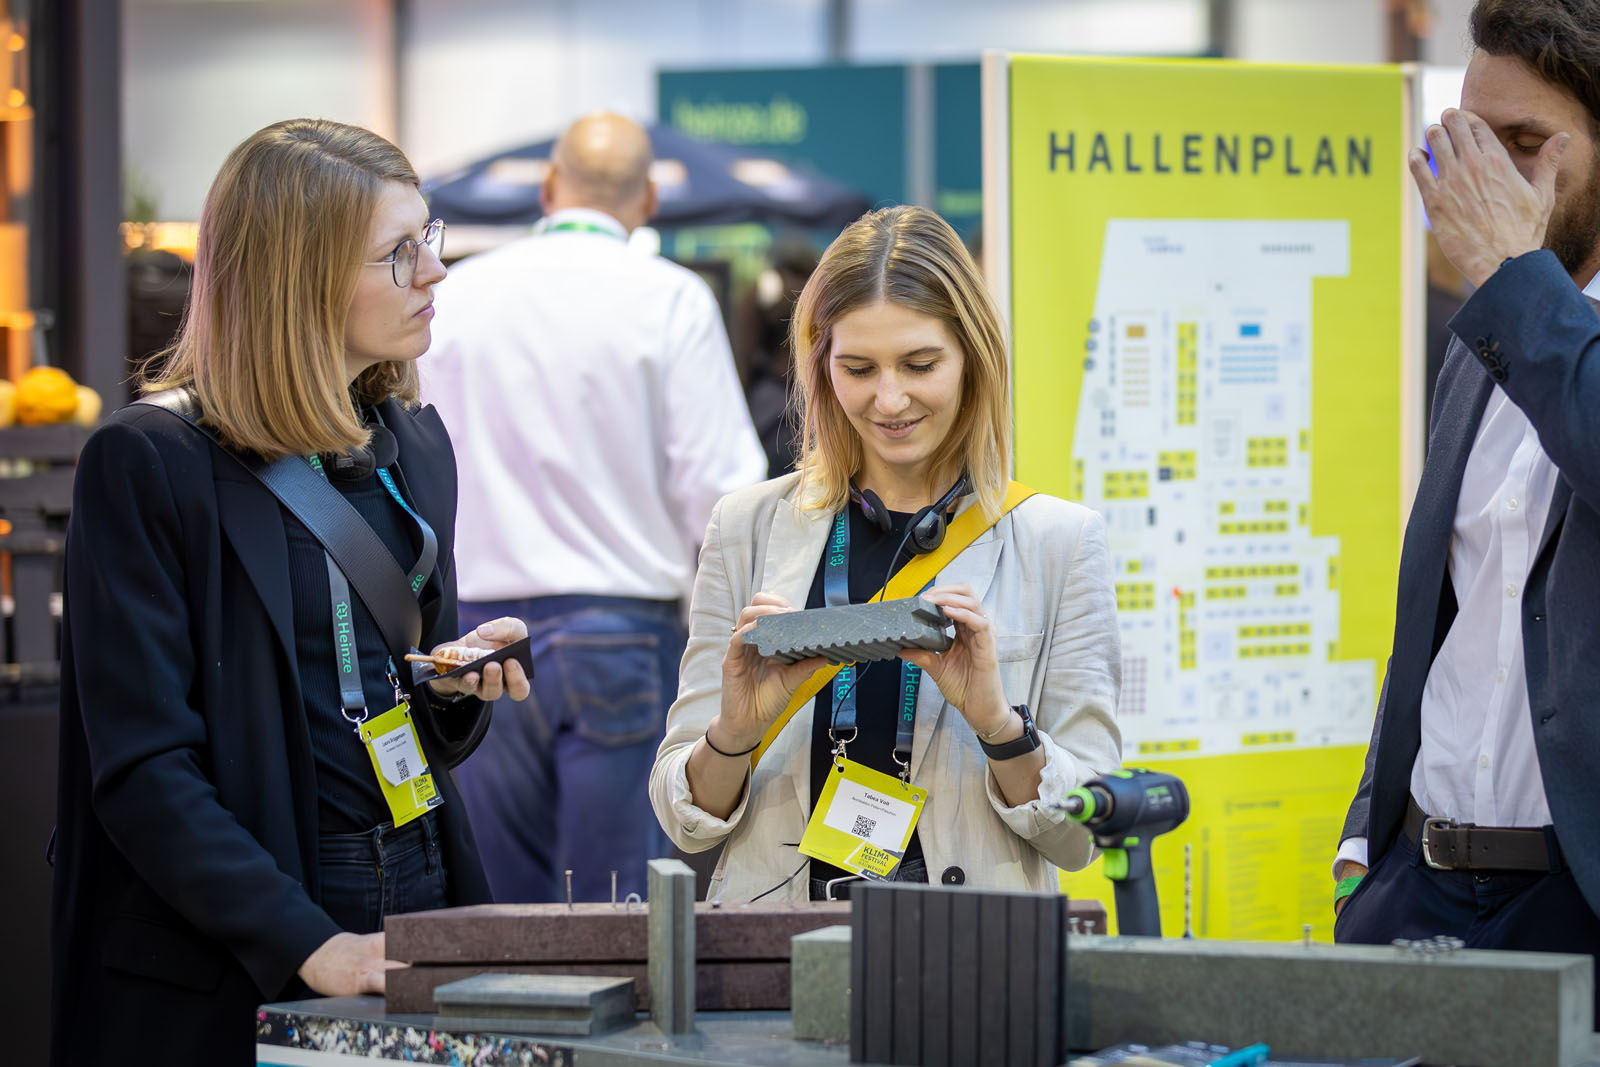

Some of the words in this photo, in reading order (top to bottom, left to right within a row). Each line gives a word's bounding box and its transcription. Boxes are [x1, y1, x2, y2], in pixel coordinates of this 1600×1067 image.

[1049, 132, 1372, 176] HALLENPLAN
[832, 513, 846, 554] Heinze
[411, 574, 425, 592] ze
[338, 622, 352, 673] Heinze
[904, 673, 920, 721] Heinze
[864, 792, 879, 802] Tabea
[860, 853, 887, 868] FESTIVAL
[863, 846, 889, 862] KLIMA
